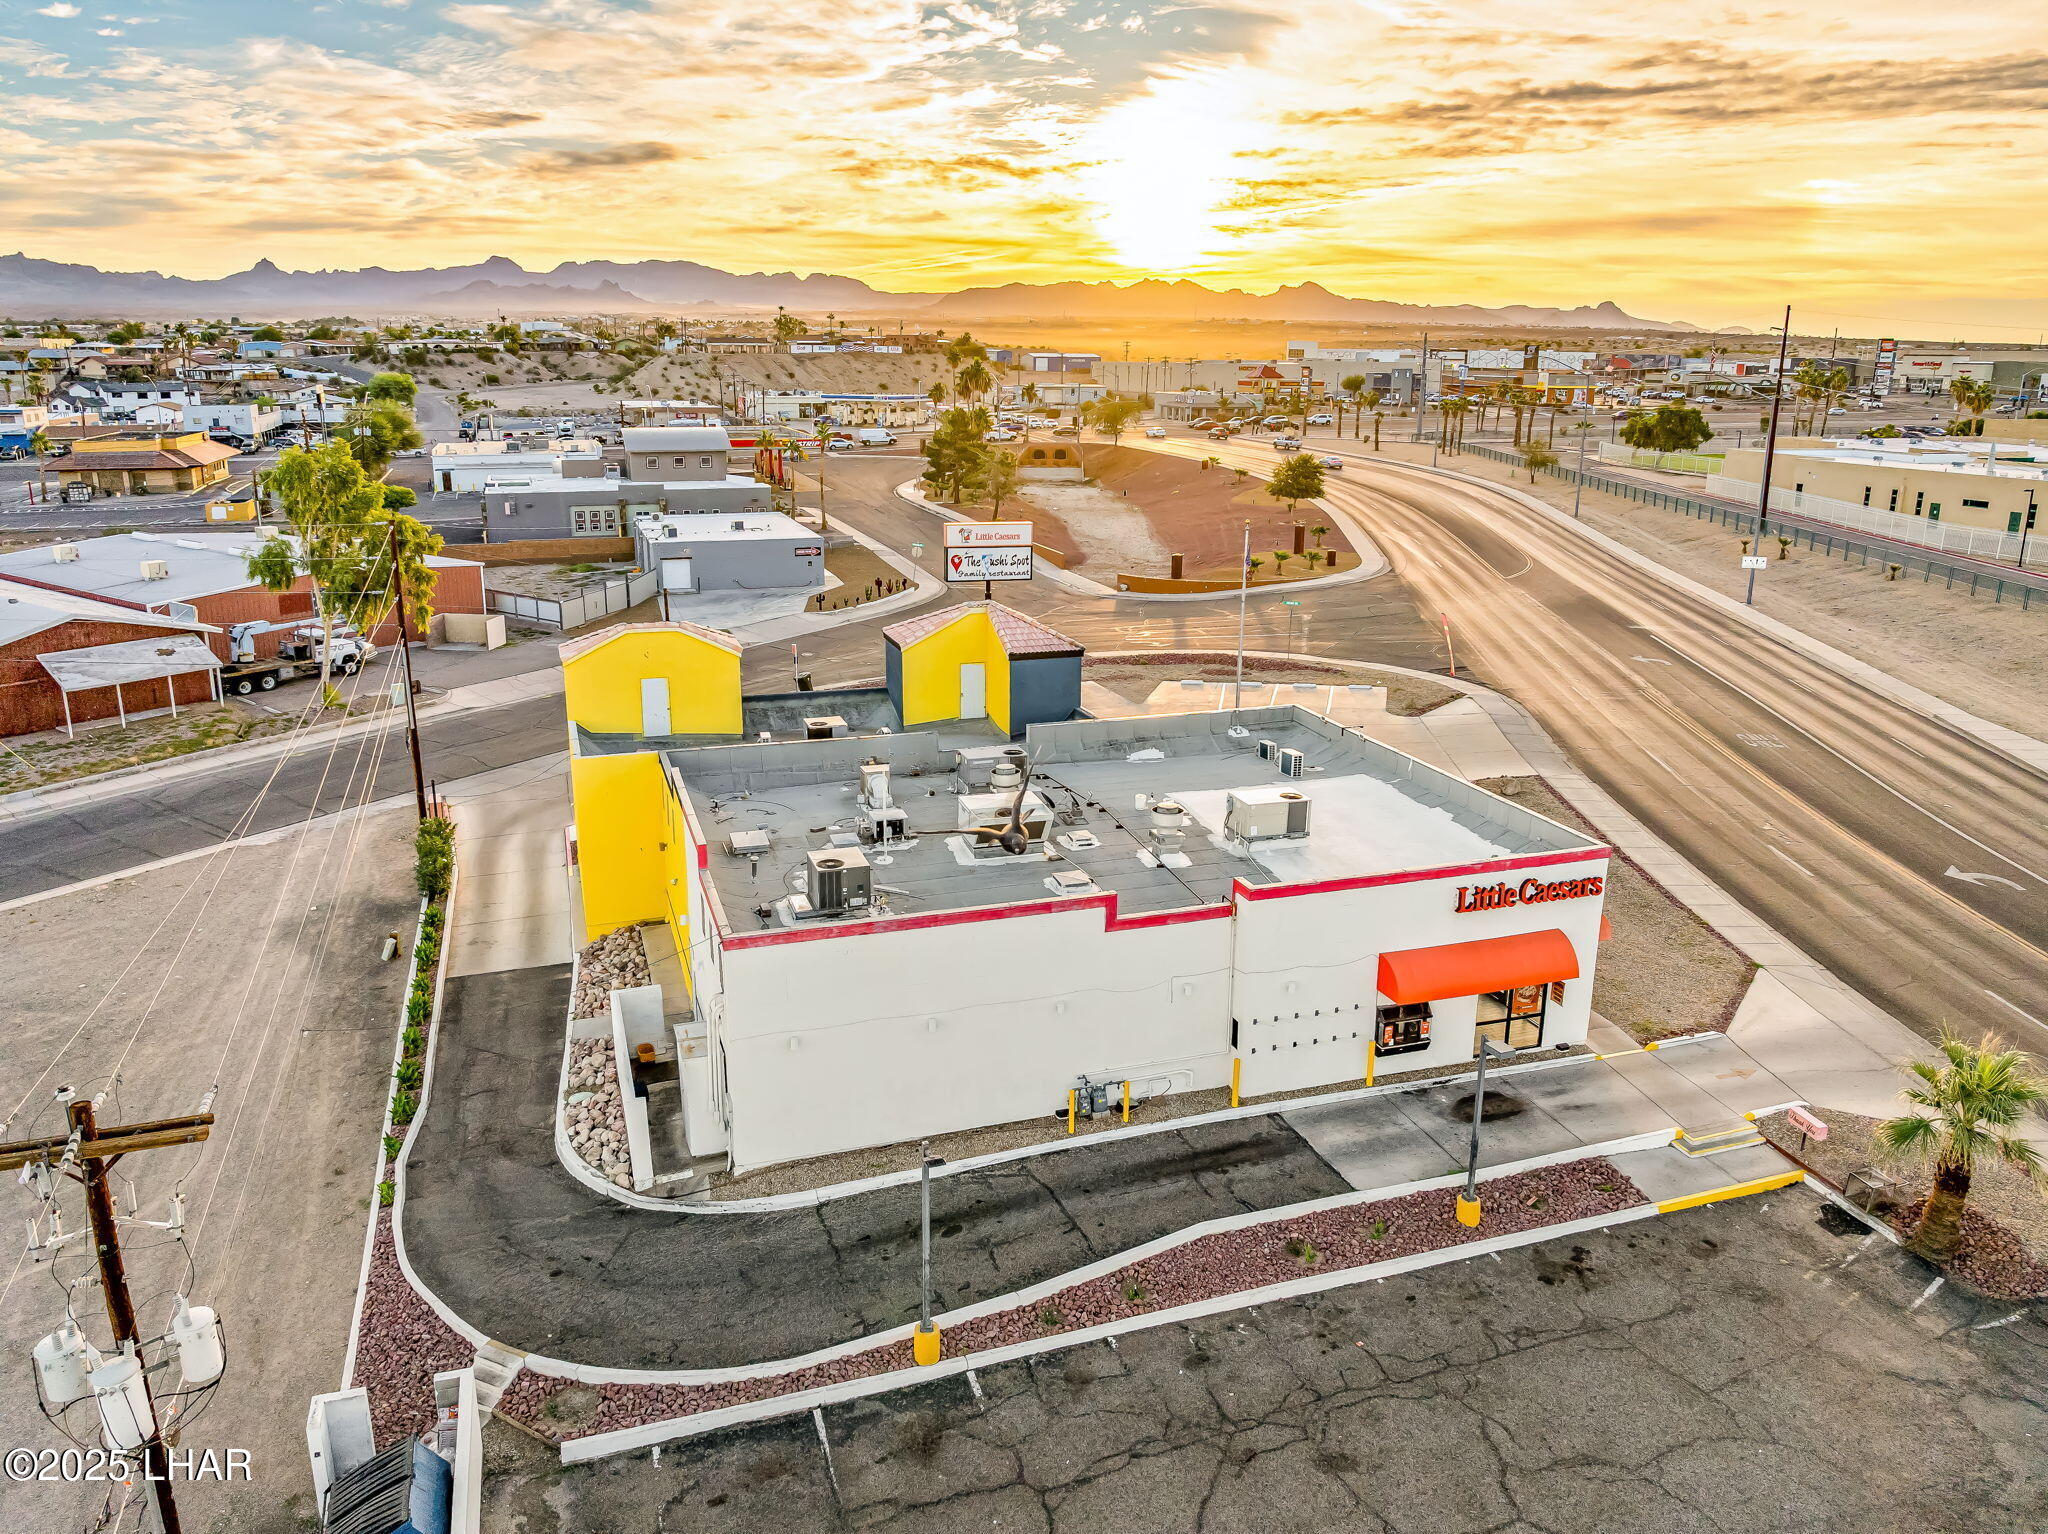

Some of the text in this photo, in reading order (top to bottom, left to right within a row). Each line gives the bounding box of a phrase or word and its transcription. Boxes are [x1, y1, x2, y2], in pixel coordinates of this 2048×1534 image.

[975, 532, 1021, 541] Little Caesars
[964, 555, 981, 567] The
[1010, 554, 1030, 569] Spot
[958, 569, 1030, 579] Family restaurant
[1455, 876, 1603, 913] Little Caesars
